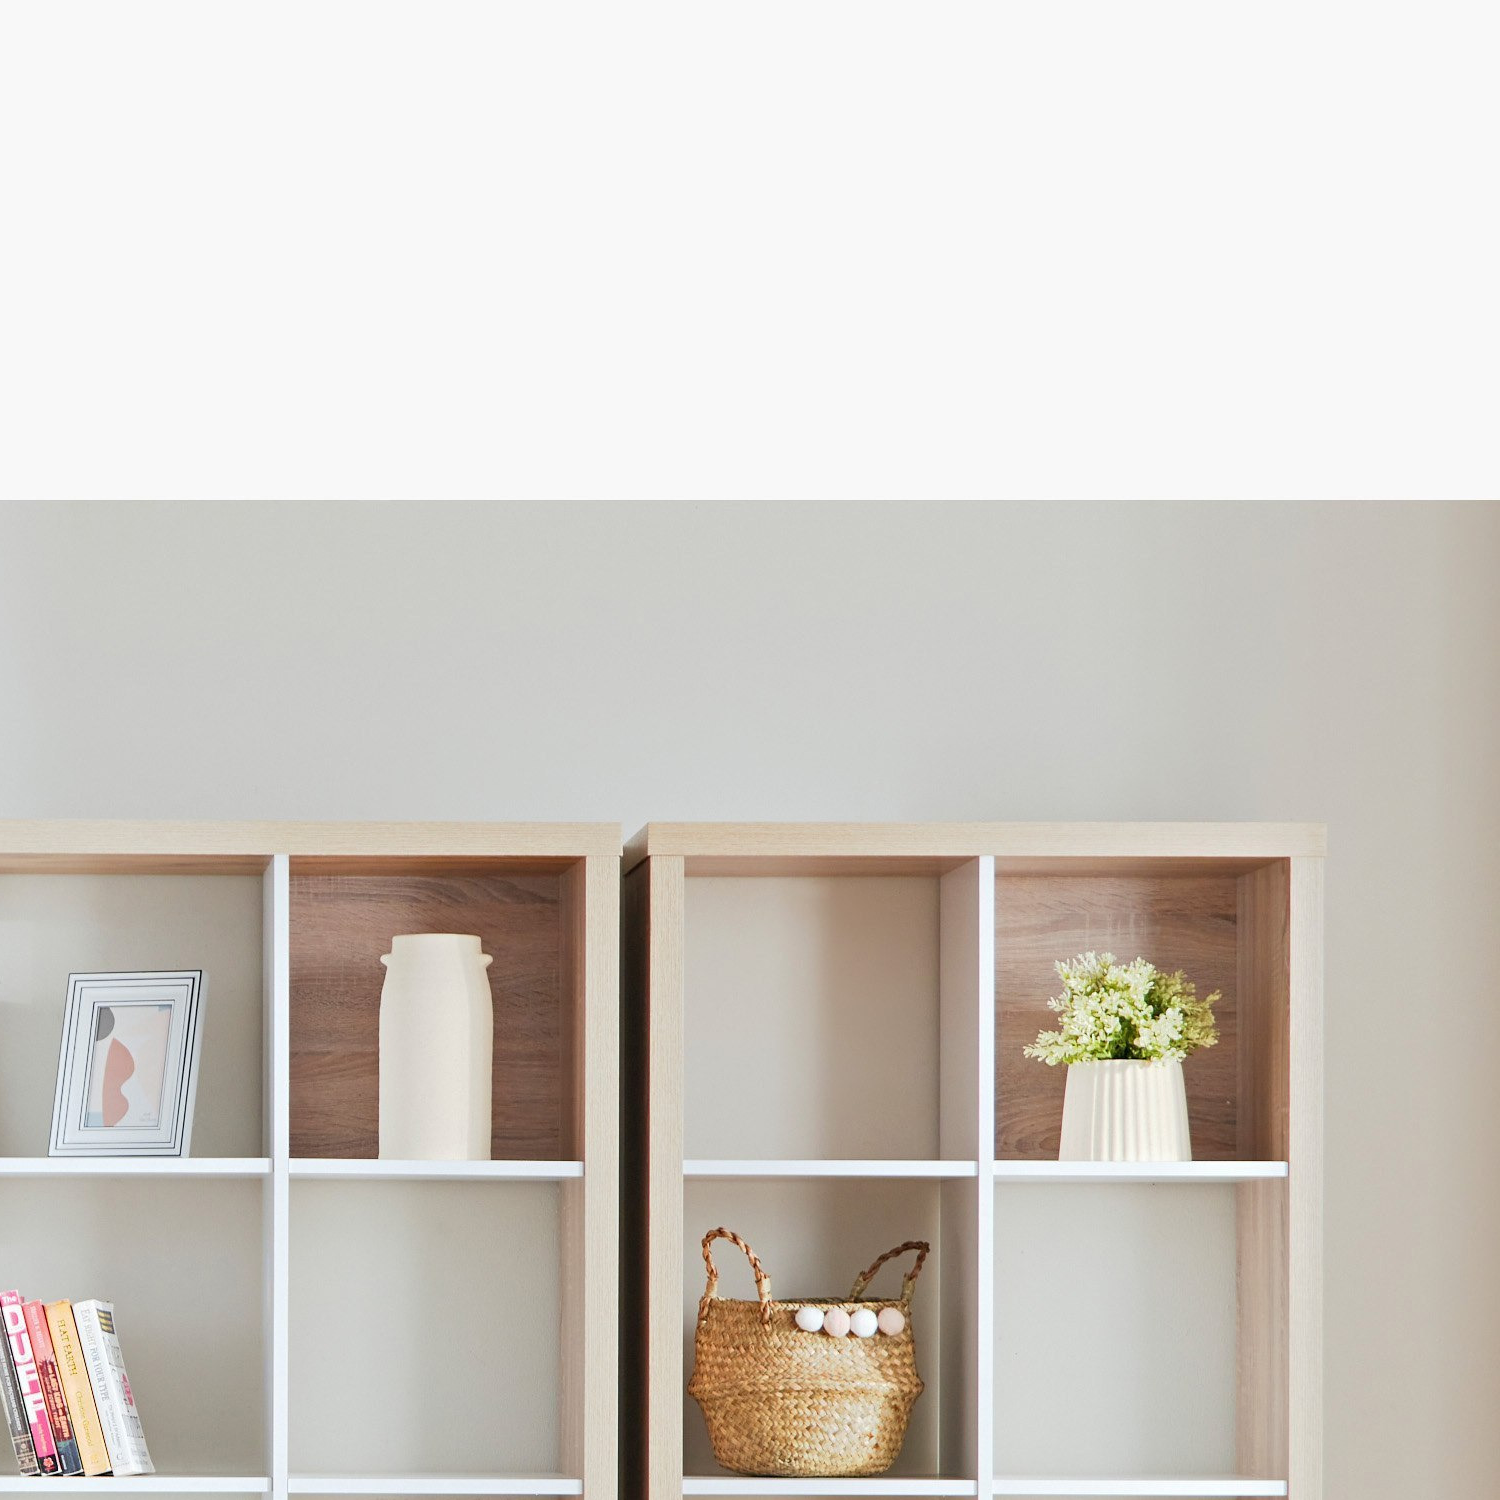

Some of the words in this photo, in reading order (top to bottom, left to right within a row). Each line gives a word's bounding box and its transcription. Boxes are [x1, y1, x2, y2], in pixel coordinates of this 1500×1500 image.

[2, 1296, 17, 1304] The
[57, 1319, 69, 1342] FLAT
[64, 1344, 78, 1376] EARTH
[2, 1304, 44, 1424] DUFF
[89, 1346, 100, 1362] FOR
[98, 1383, 109, 1401] TYPE
[48, 1373, 59, 1391] LAST
[52, 1391, 63, 1408] KIDS
[58, 1414, 70, 1438] EARTH
